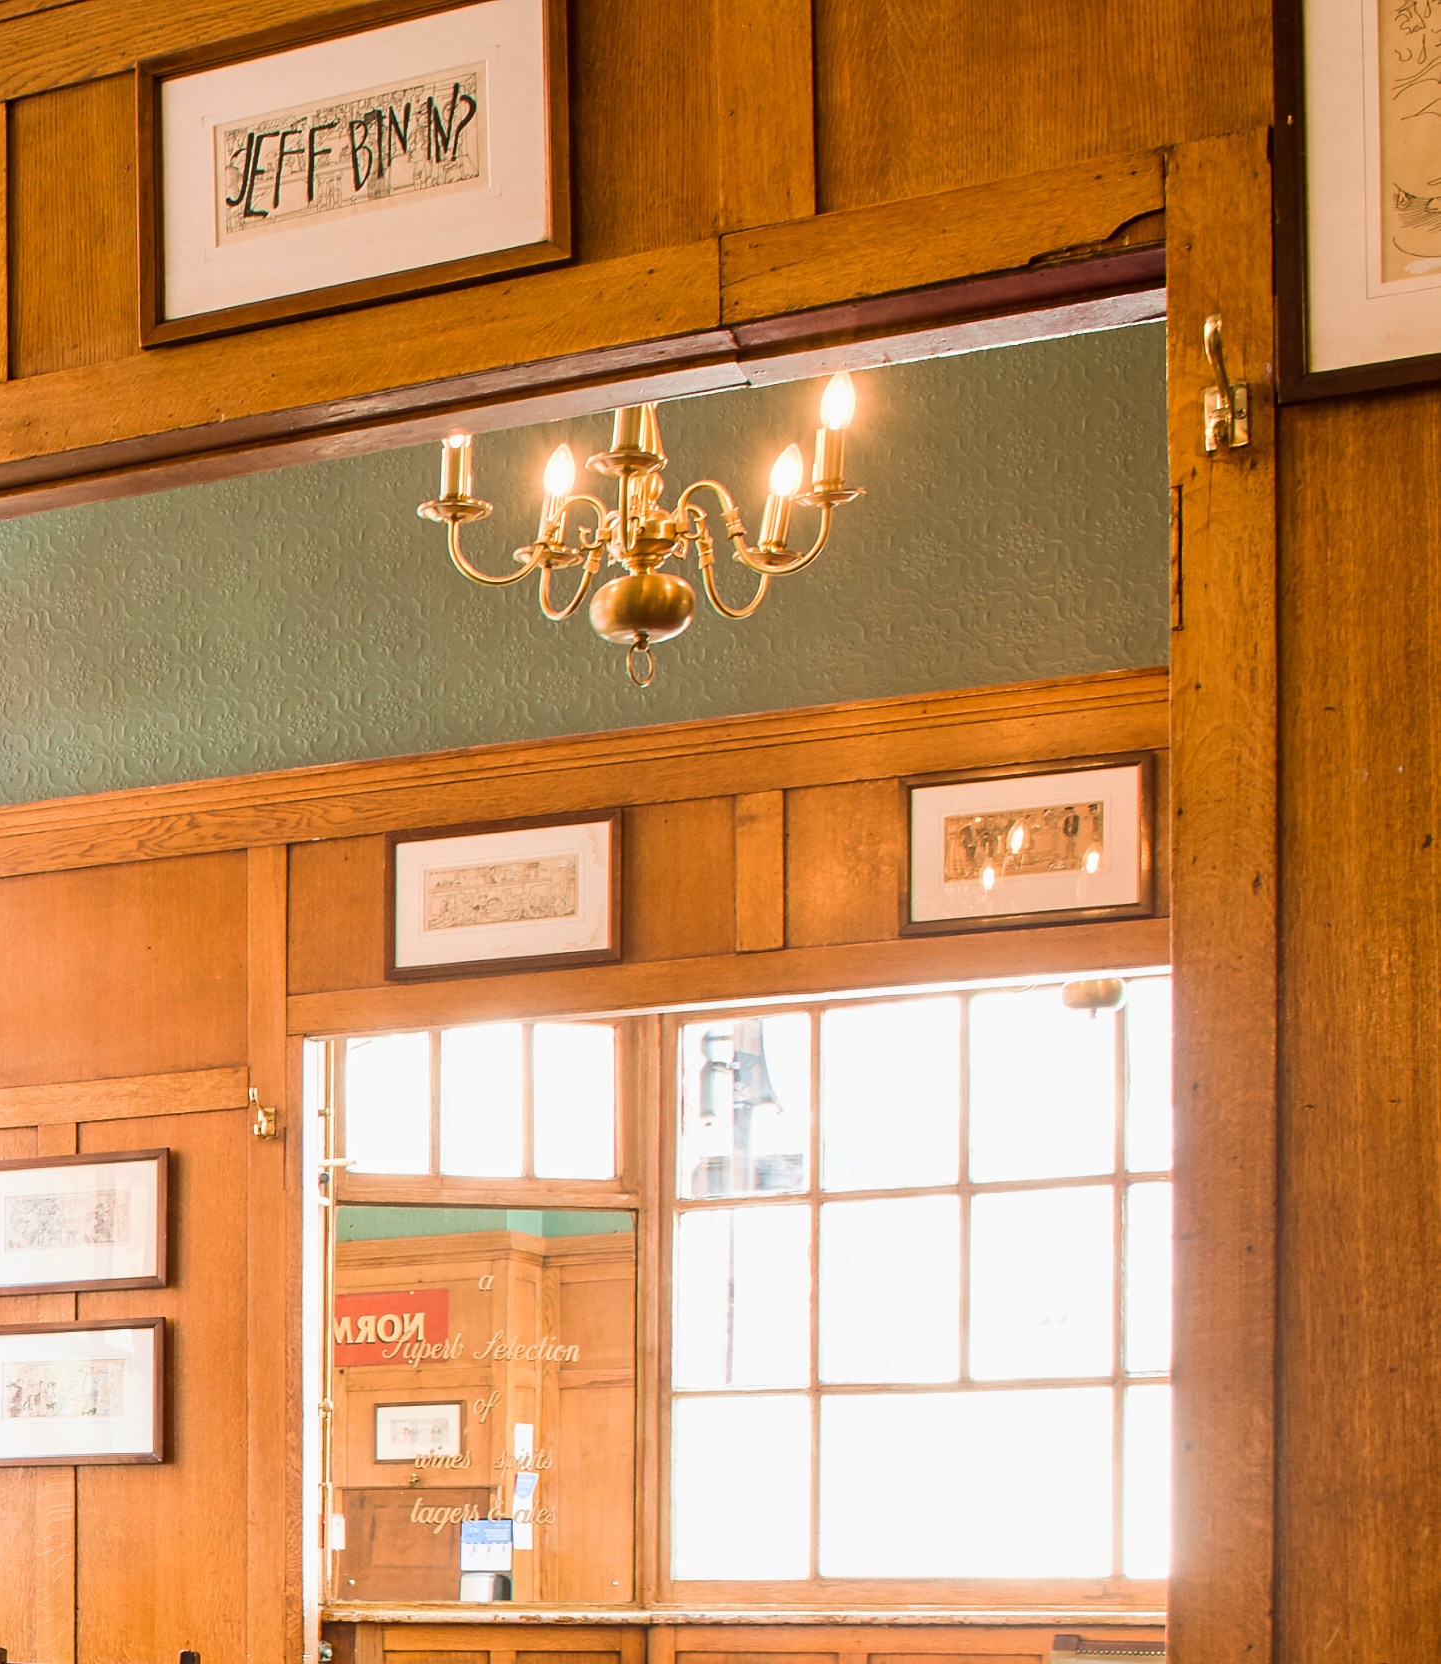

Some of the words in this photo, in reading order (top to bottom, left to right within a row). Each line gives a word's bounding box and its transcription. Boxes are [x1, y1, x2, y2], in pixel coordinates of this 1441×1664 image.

[225, 122, 337, 219] JEFF
[348, 102, 411, 192] BIN
[477, 1273, 495, 1292] a
[381, 1331, 465, 1369] Superb
[473, 1329, 581, 1363] Selection
[473, 1390, 502, 1424] of
[414, 1446, 472, 1470] wines
[494, 1448, 554, 1479] spirits
[410, 1497, 480, 1535] lagers
[514, 1501, 557, 1525] ales
